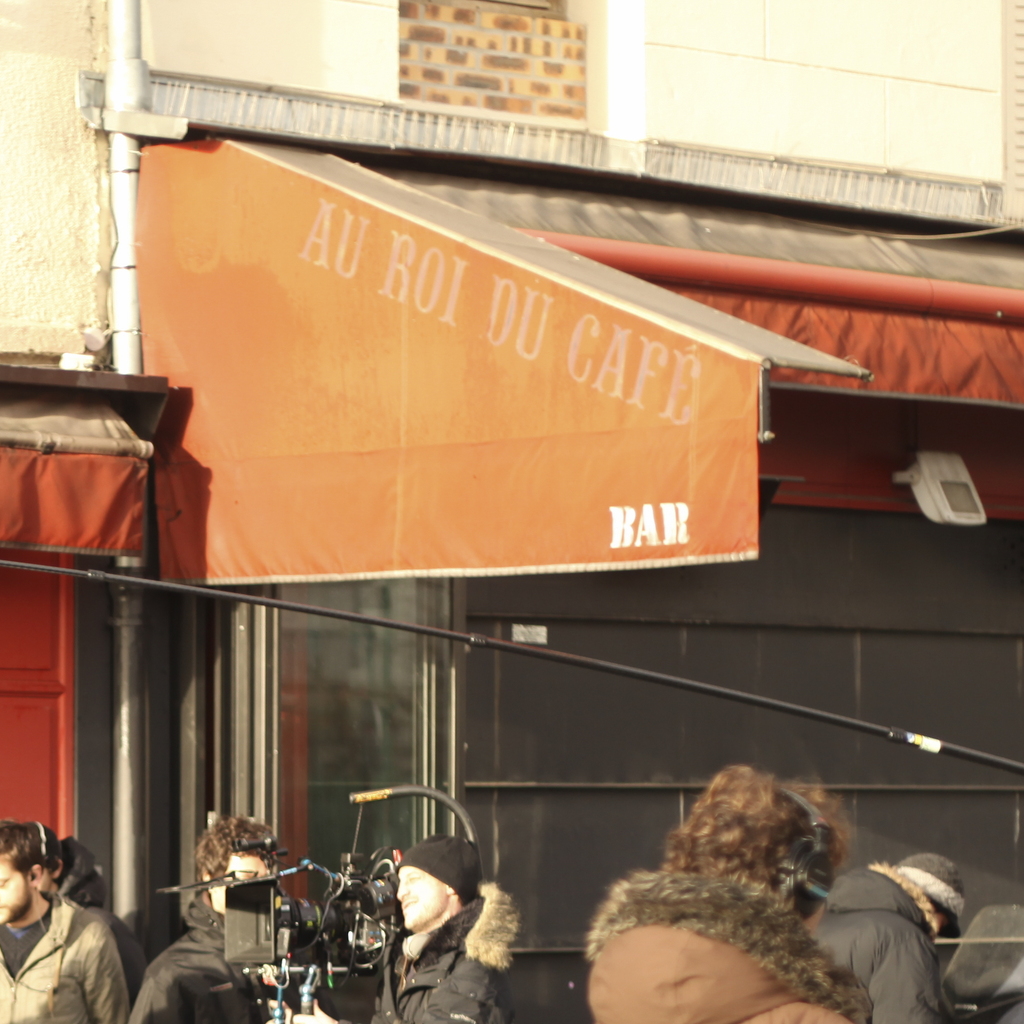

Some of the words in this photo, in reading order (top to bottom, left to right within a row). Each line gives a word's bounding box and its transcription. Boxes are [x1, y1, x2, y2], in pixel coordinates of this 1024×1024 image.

[298, 198, 371, 279] AU
[378, 229, 471, 327] ROI
[486, 273, 554, 361] DU
[567, 313, 702, 426] CAFÉ
[608, 501, 691, 549] BAR
